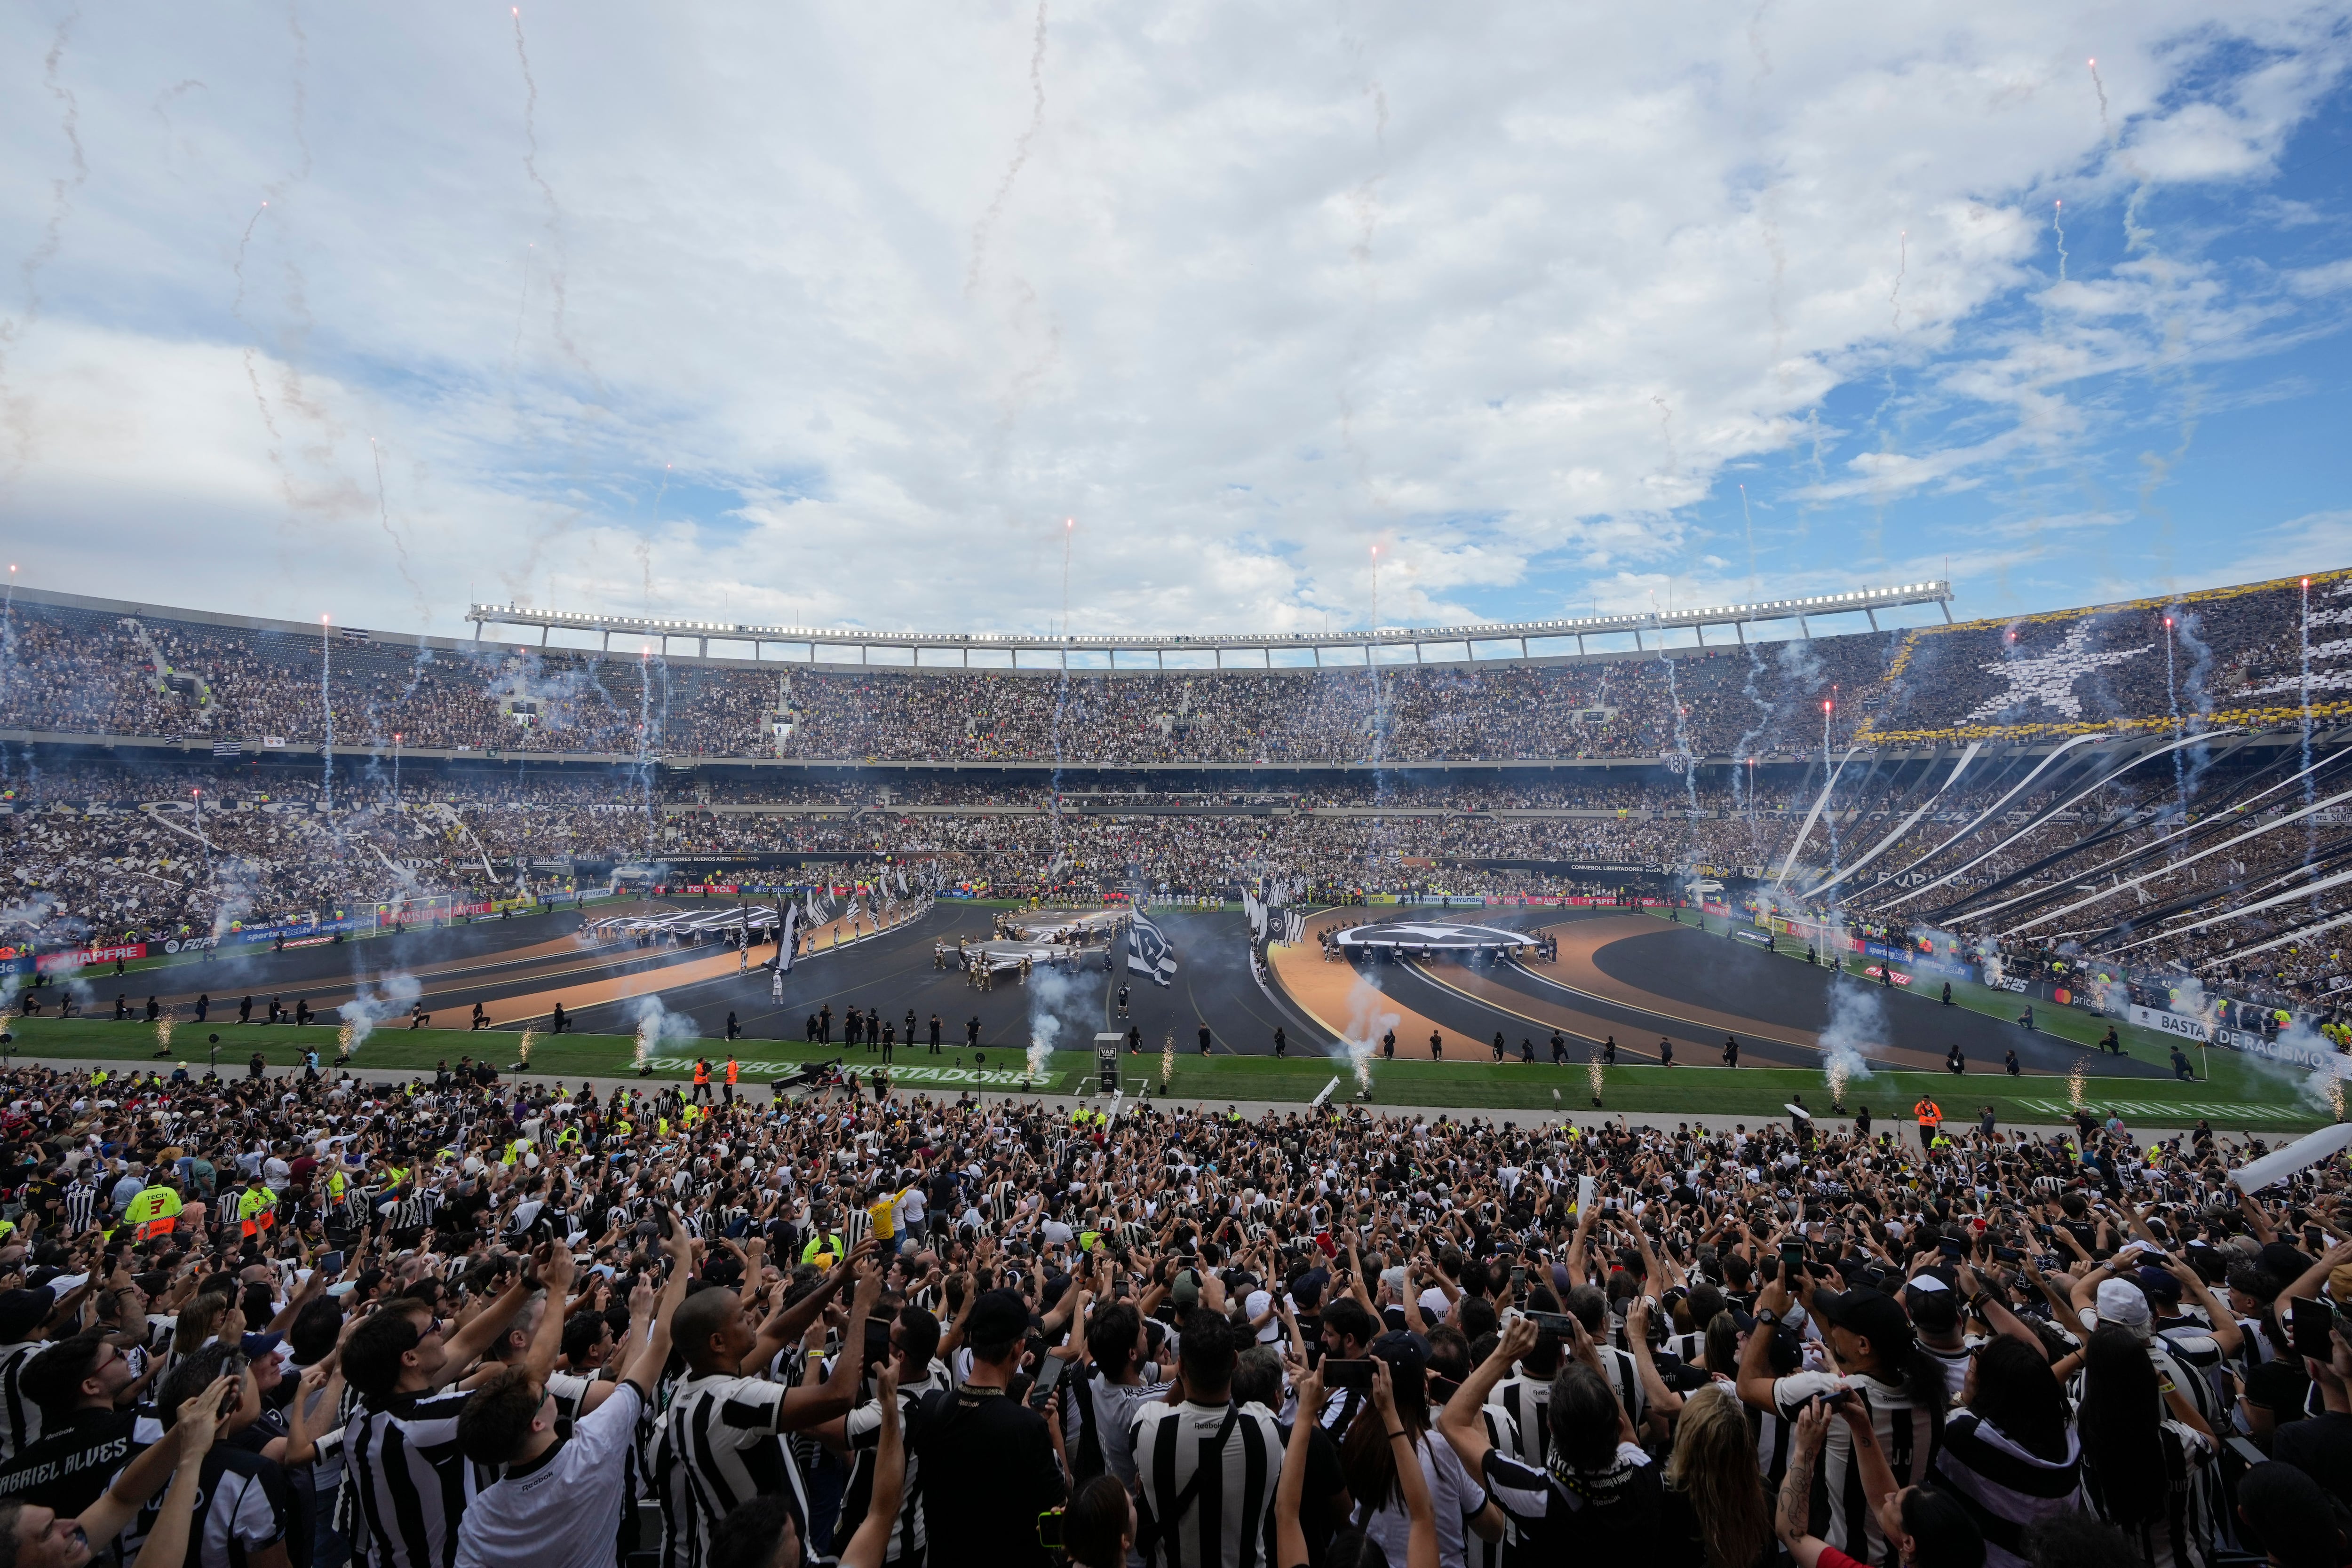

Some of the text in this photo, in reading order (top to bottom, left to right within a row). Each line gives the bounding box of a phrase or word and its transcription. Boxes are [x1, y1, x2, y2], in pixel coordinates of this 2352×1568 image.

[400, 910, 434, 923] AMSTEL
[1708, 905, 1725, 916] MAPFRE
[1733, 912, 1754, 922] crypto.com
[62, 947, 137, 965] MAPFRE
[1917, 958, 1966, 976] sportingbet.tv
[2073, 995, 2115, 1013] priceless
[2161, 1015, 2324, 1068] BASTA DE RACISMO
[2018, 1099, 2070, 1112] LA
[2180, 1103, 2313, 1120] ETERNA
[150, 1225, 168, 1234] GURIDAD
[958, 1399, 979, 1408] Reebok
[45, 1427, 75, 1440] Reebok
[64, 1437, 127, 1476] ALVES
[522, 1471, 554, 1492] Reebok
